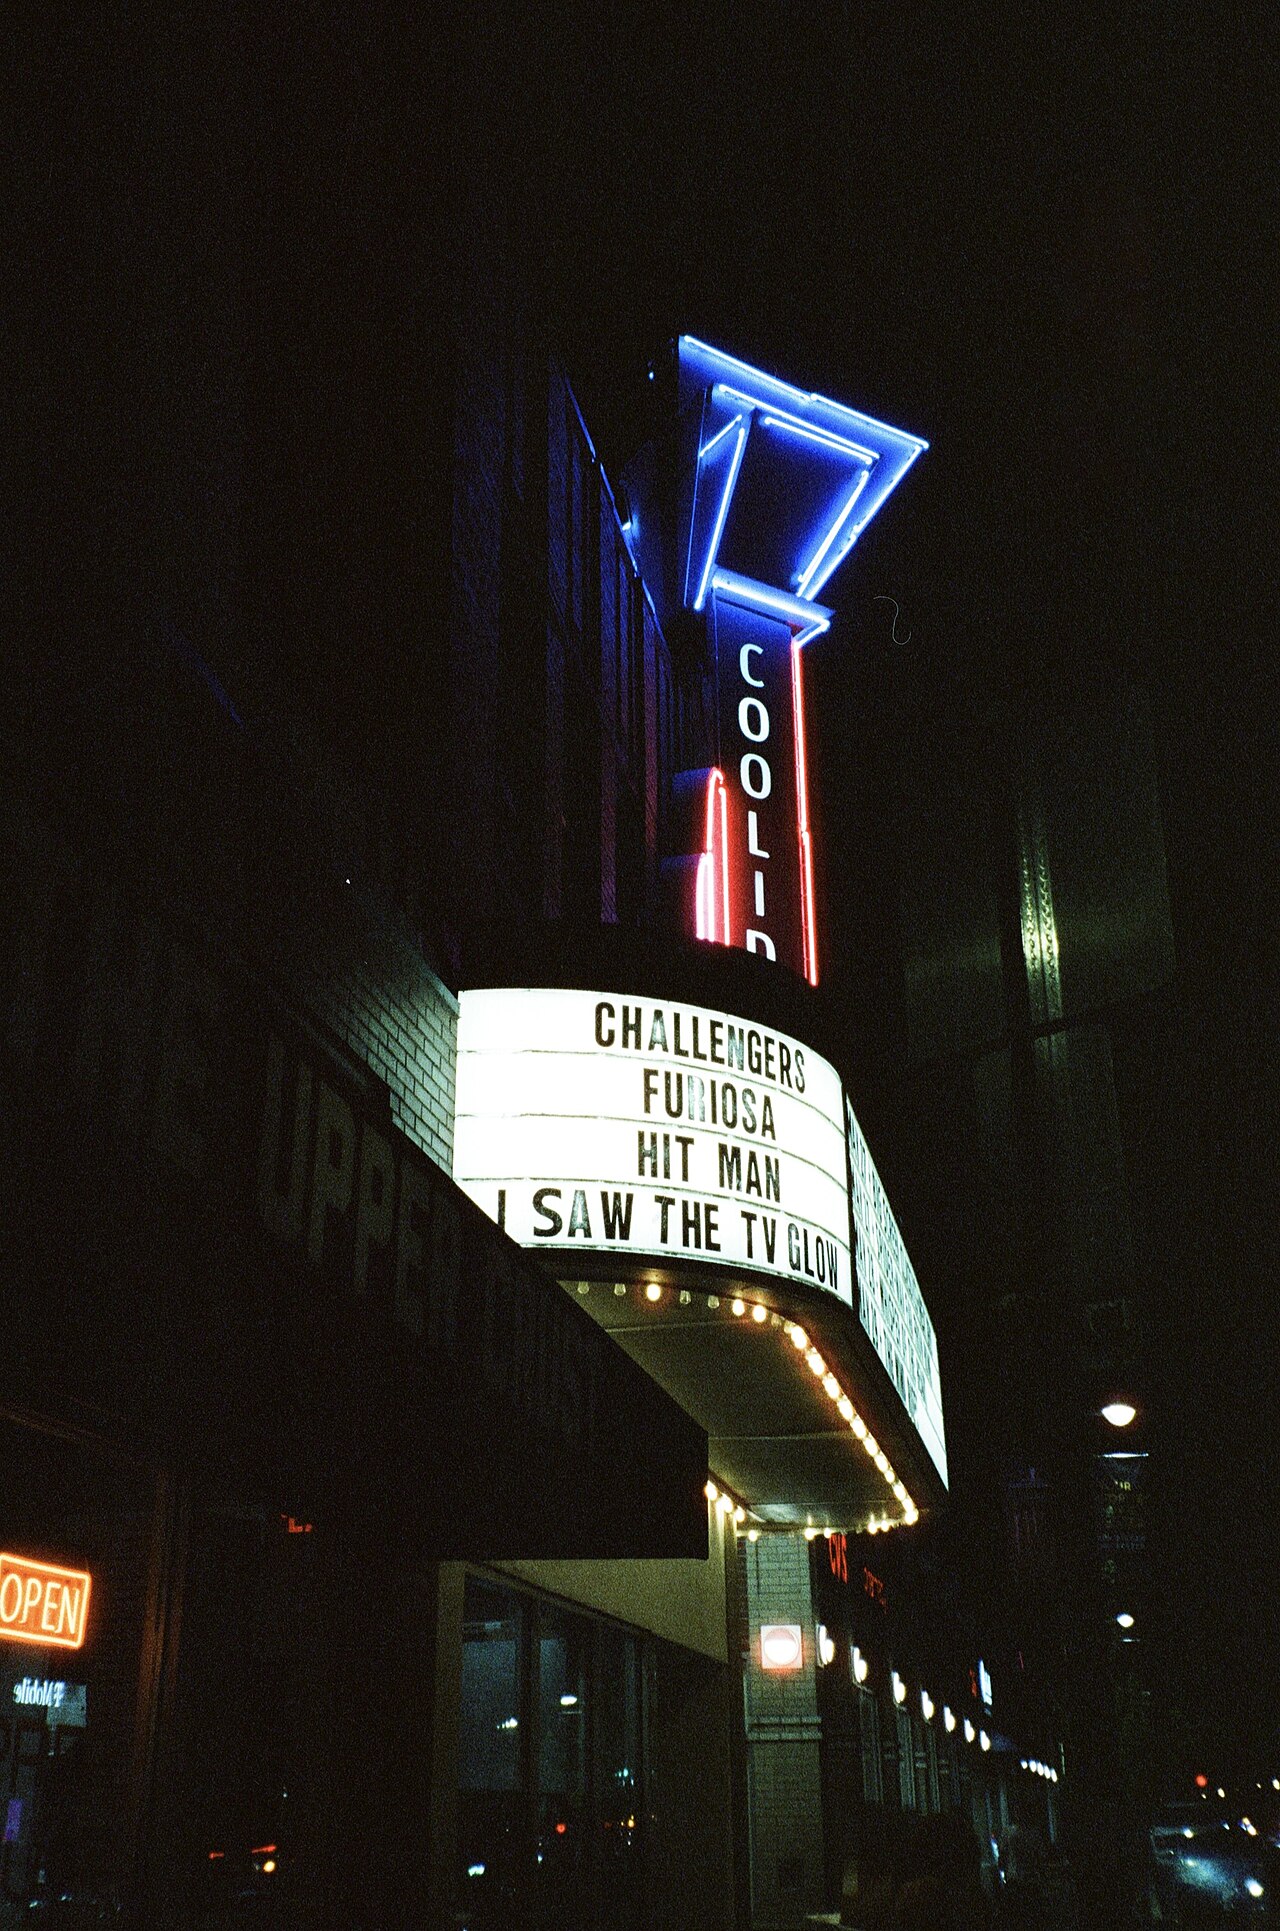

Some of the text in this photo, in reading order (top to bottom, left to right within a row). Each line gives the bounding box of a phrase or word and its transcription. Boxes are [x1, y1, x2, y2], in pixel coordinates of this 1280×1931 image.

[594, 1001, 806, 1094] CHALLENGERS
[643, 1068, 776, 1141] FURIOSA
[258, 1030, 462, 1352] UPPER
[637, 1130, 781, 1203] HIT MAN
[498, 1187, 839, 1291] I SAW THE TV GLOW
[0, 1573, 80, 1635] OPEN
